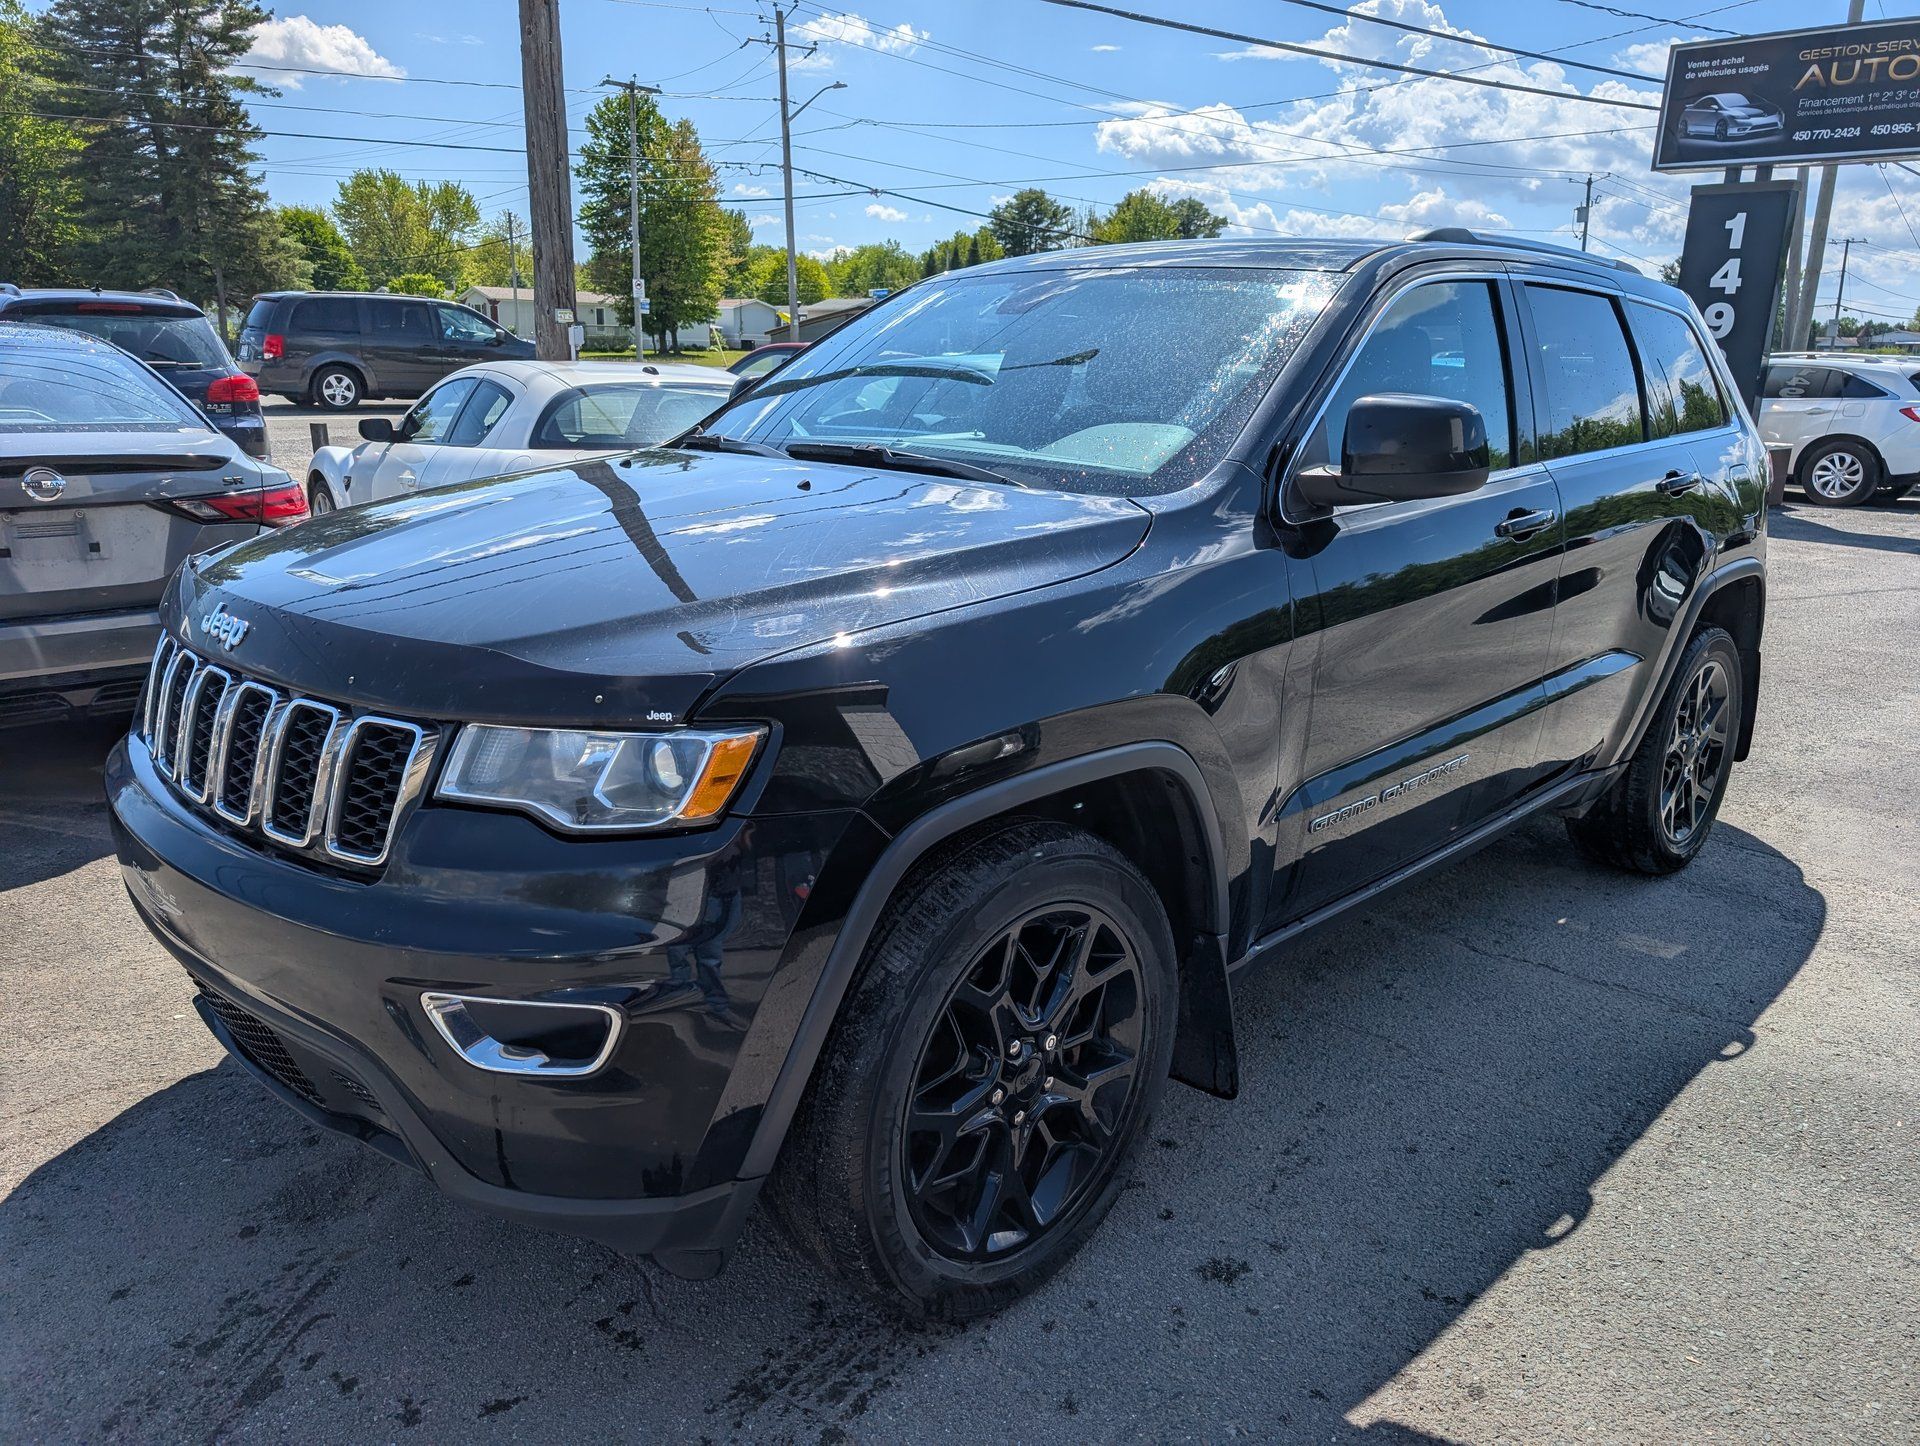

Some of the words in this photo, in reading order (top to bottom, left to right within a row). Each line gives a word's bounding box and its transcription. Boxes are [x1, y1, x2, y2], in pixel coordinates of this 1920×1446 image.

[1799, 43, 1872, 61] GESTION
[1687, 60, 1710, 69] Vente
[1711, 58, 1720, 67] et
[1721, 56, 1745, 66] achat
[1685, 71, 1696, 79] de
[1697, 67, 1737, 78] véhicules
[1738, 63, 1770, 74] usagés
[1792, 54, 1920, 91] AUTO
[1798, 94, 1864, 108] Financement
[1796, 109, 1823, 117] Services
[1873, 102, 1908, 111] esthétique
[1792, 130, 1811, 141] 450
[1812, 126, 1861, 140] 770-2424
[1870, 124, 1891, 135] 450
[1704, 212, 1747, 360] 149
[223, 476, 244, 486] SR
[201, 601, 249, 652] Jeep
[646, 710, 673, 722] Jeep
[1309, 795, 1378, 834] GRAND
[1380, 754, 1470, 803] CHEROKEE
